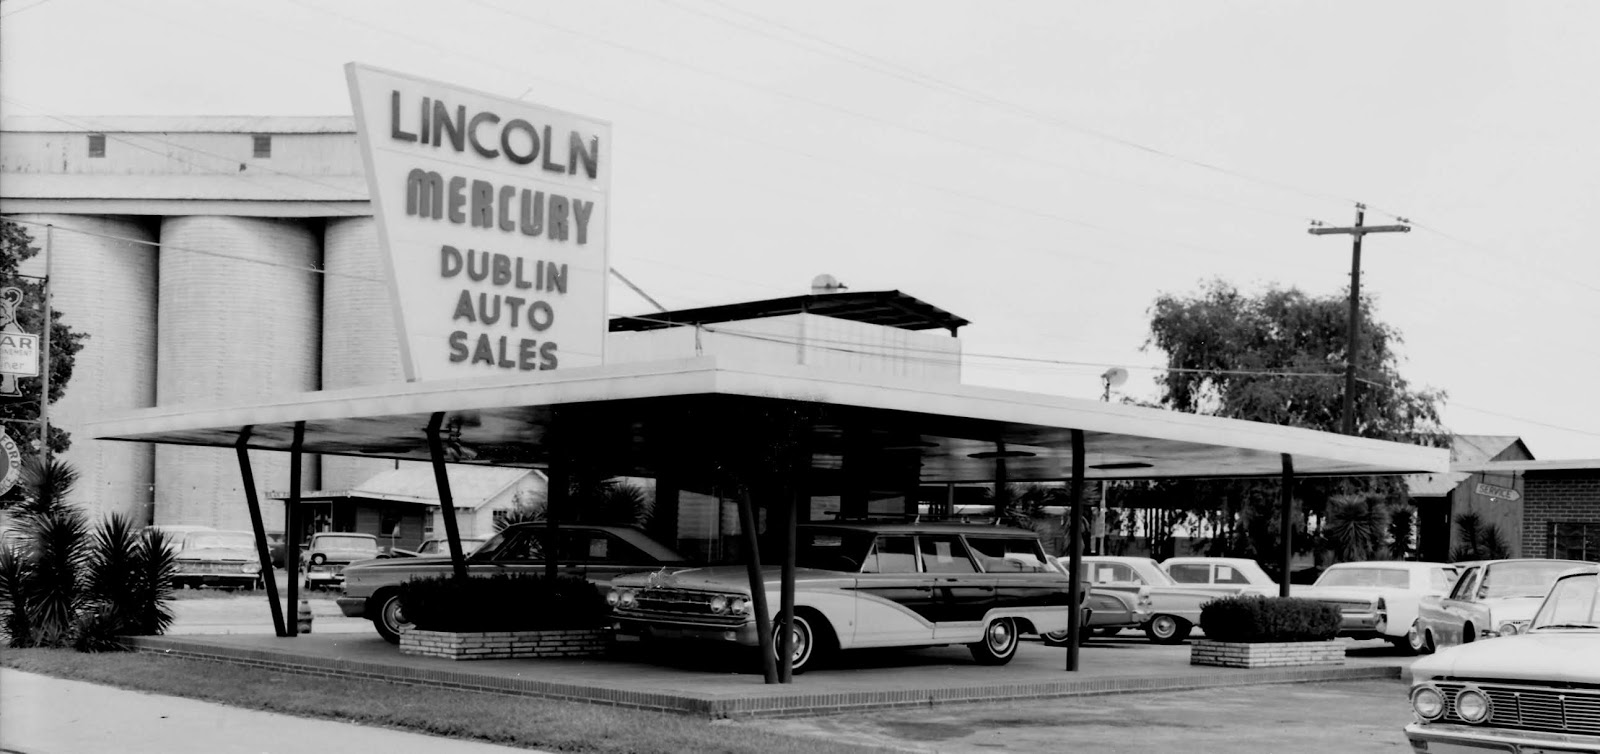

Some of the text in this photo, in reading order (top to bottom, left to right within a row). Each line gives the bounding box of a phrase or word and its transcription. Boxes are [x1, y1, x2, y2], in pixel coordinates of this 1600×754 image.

[391, 89, 599, 180] LINCOLN
[406, 167, 595, 245] MERCURY
[440, 244, 569, 294] DUBLIN
[452, 288, 555, 332] AUTO
[448, 330, 559, 371] SALES
[1479, 485, 1512, 499] SERVICE
